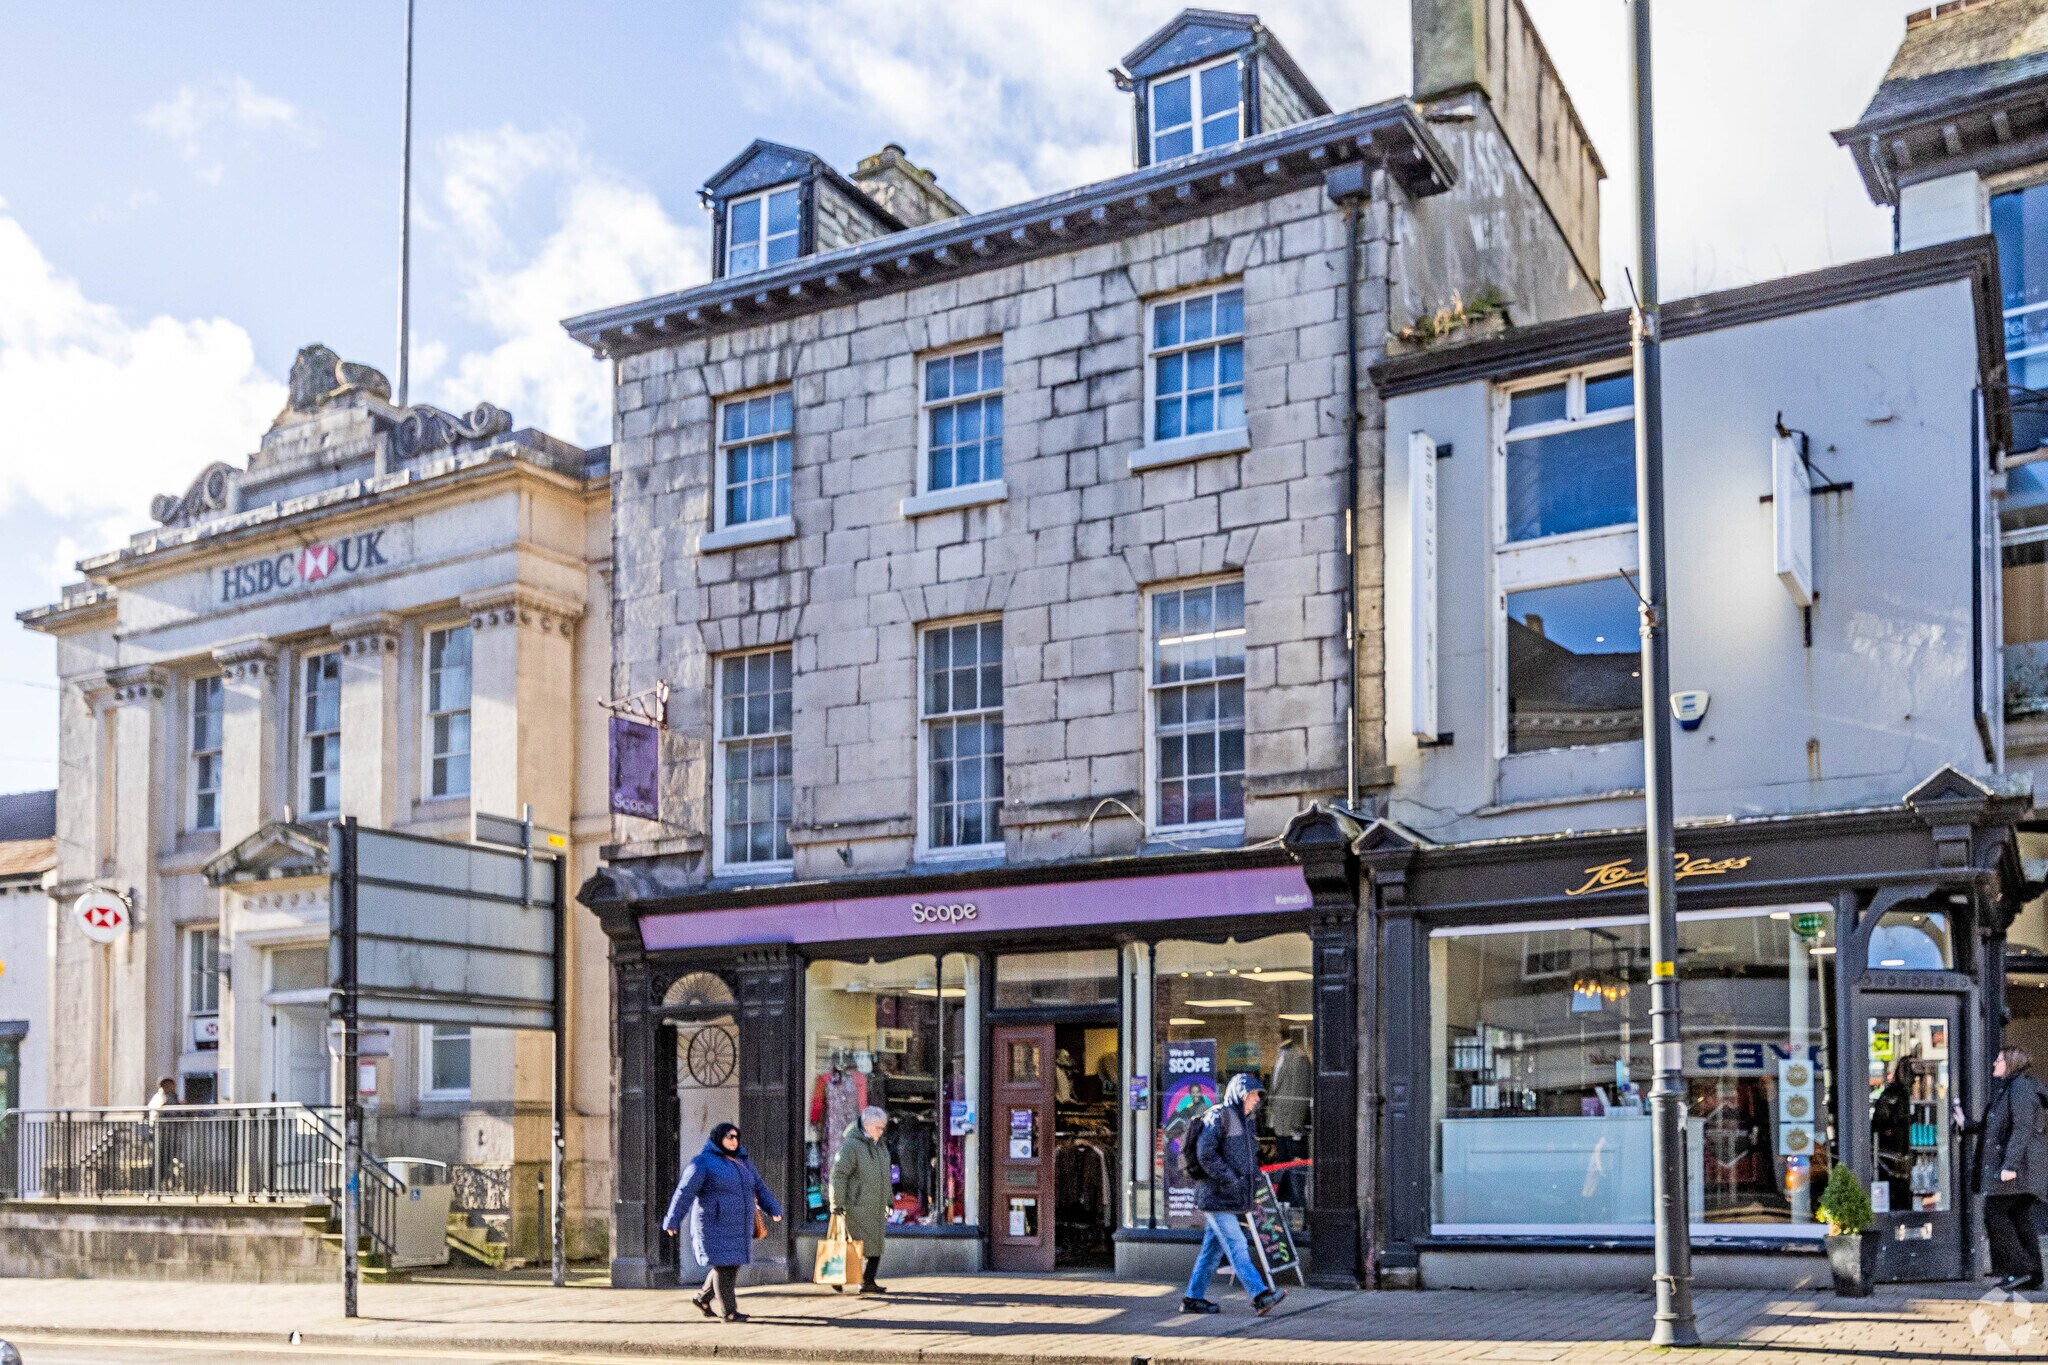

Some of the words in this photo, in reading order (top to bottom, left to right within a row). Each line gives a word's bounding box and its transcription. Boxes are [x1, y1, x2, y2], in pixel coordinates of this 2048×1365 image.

[222, 552, 295, 602] HSBC
[340, 530, 388, 573] UK
[613, 792, 655, 815] Scope
[911, 902, 978, 925] Scope
[1168, 1057, 1210, 1073] SCOPE
